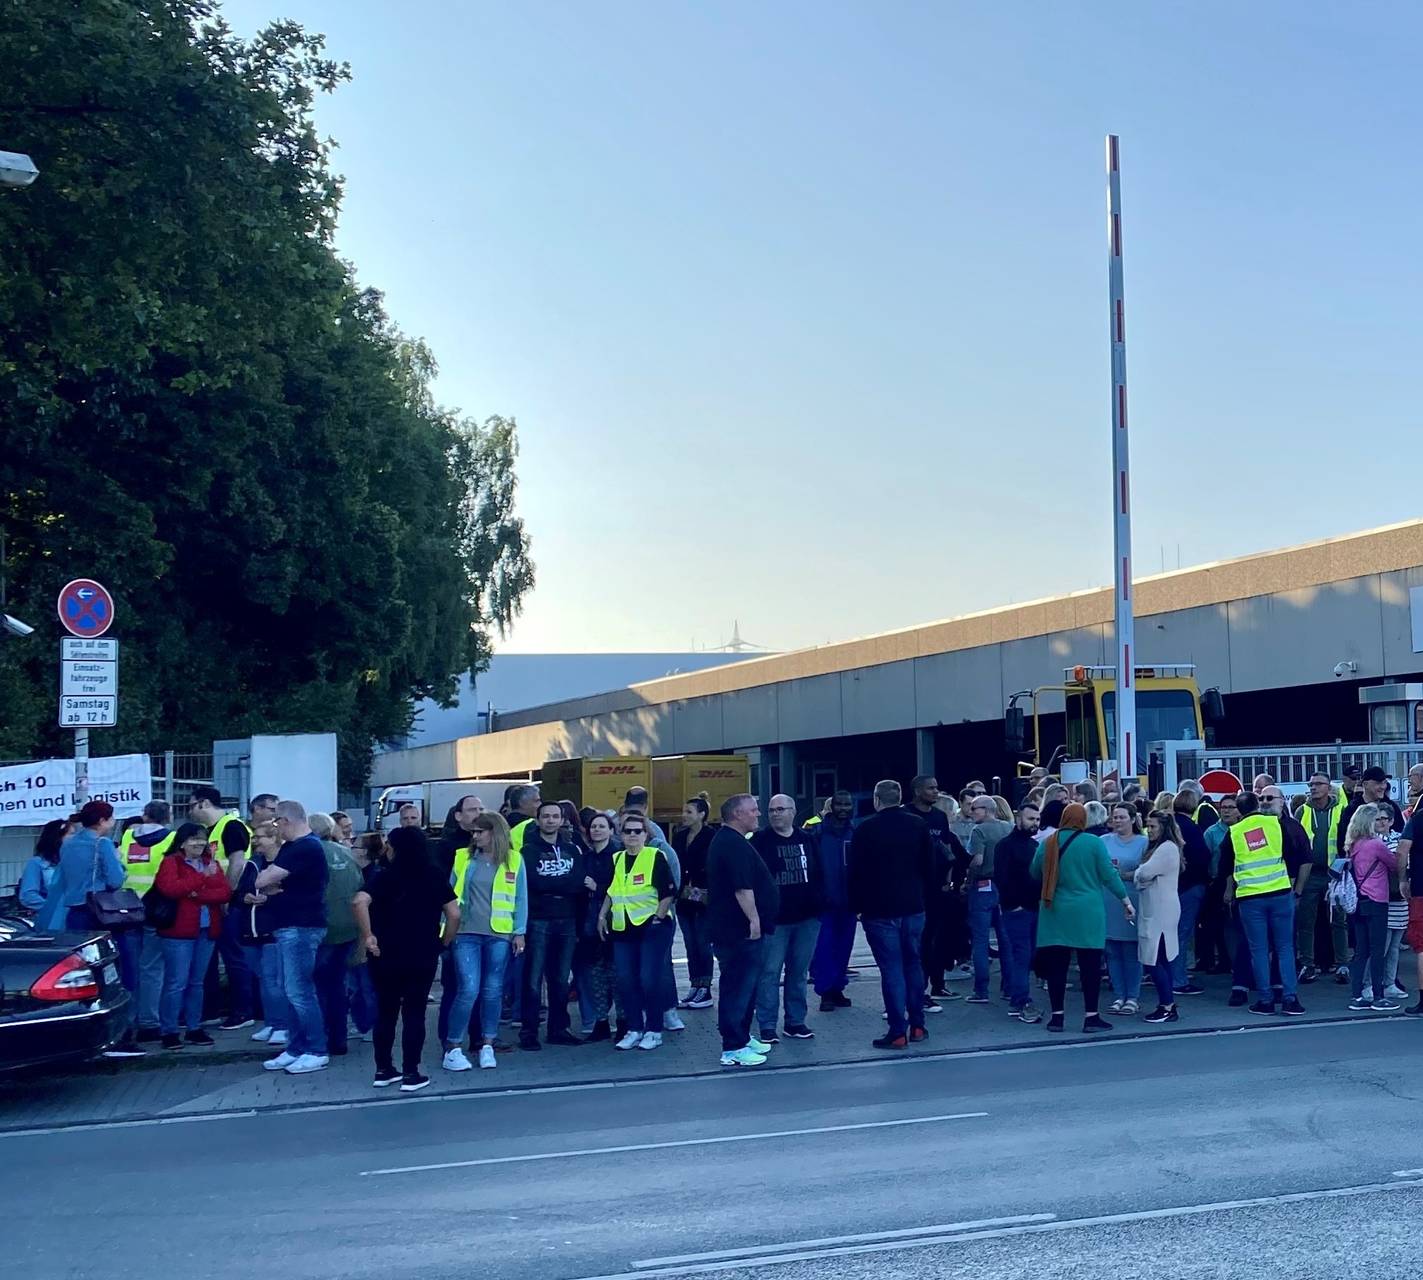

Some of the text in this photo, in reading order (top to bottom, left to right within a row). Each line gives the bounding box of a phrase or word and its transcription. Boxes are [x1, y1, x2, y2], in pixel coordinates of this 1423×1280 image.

[66, 699, 110, 711] Samstag
[67, 712, 108, 722] ab 12 h
[598, 765, 636, 775] DHL
[699, 769, 736, 778] DHL
[24, 776, 46, 789] 10
[33, 793, 65, 808] und
[72, 789, 140, 804] Lgistik
